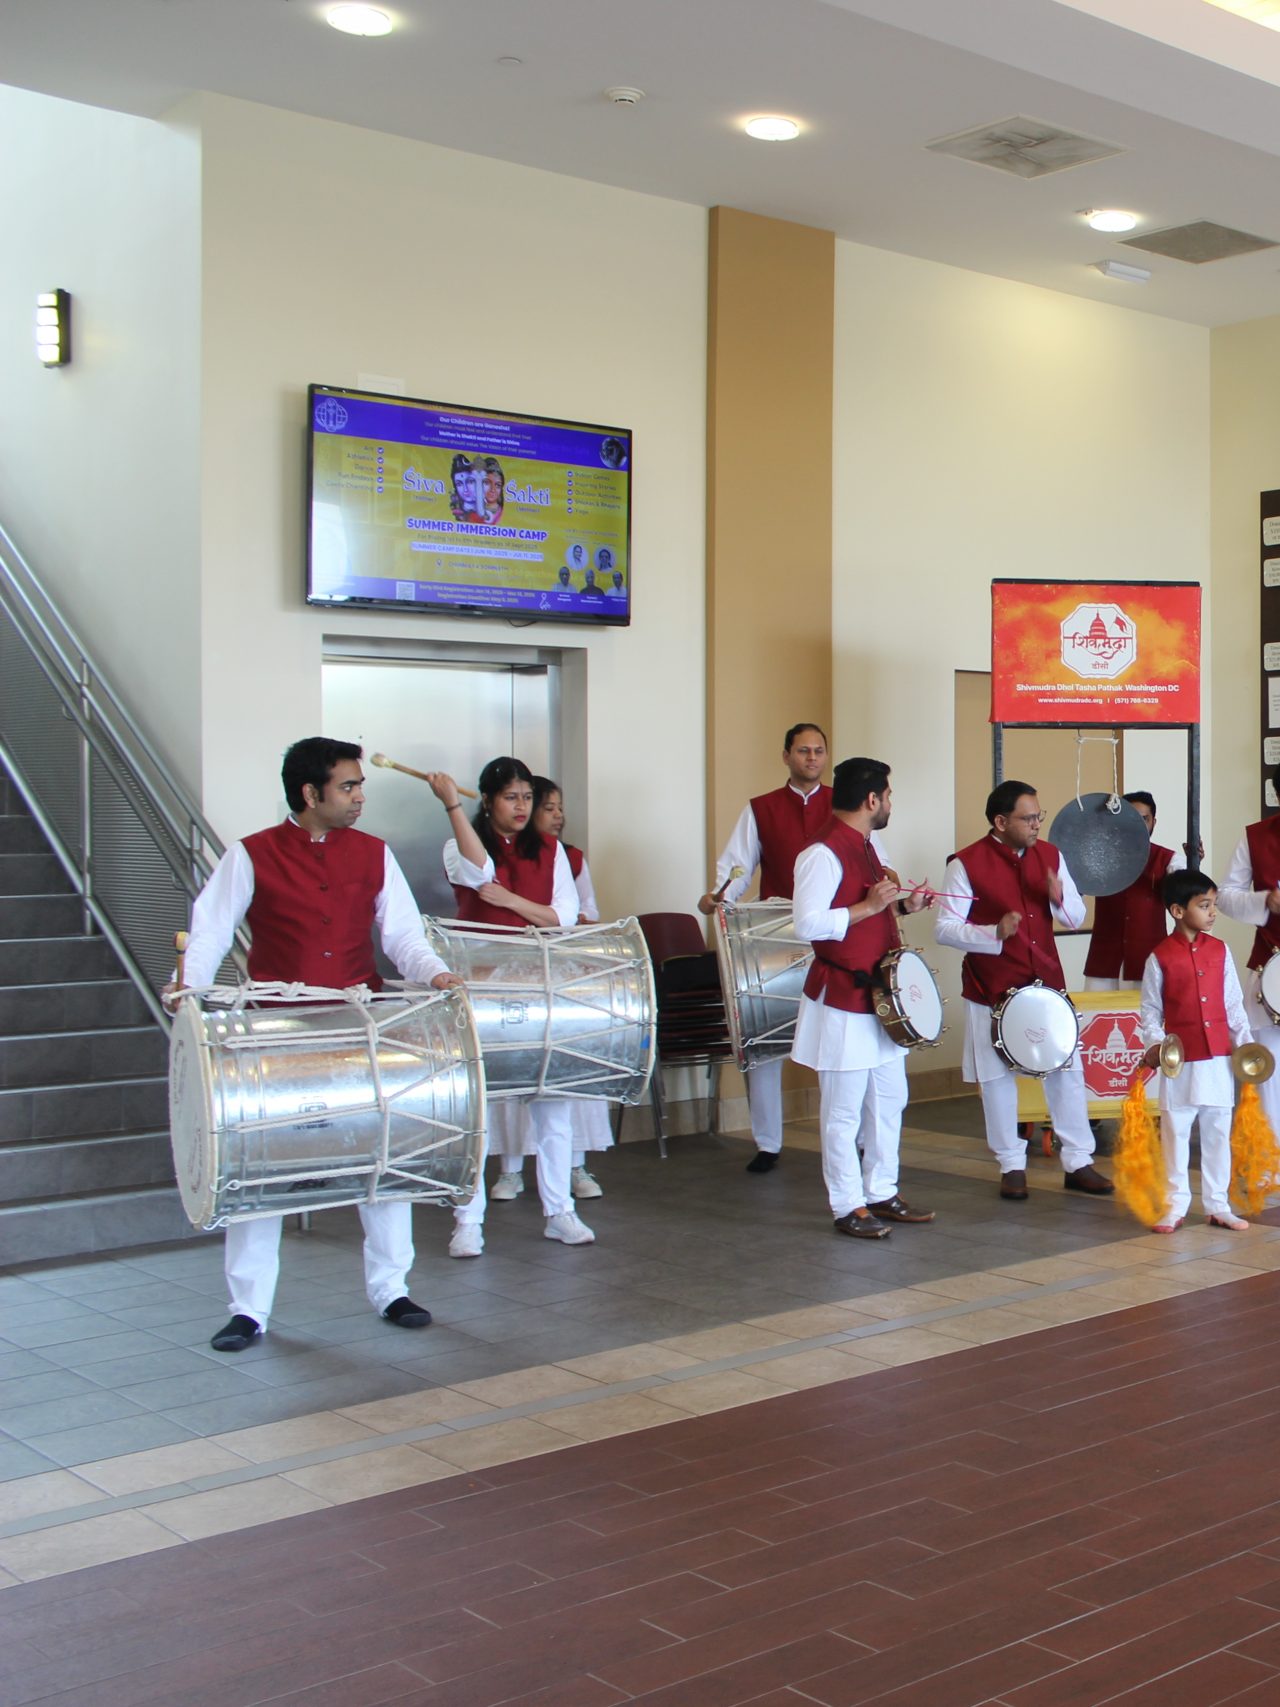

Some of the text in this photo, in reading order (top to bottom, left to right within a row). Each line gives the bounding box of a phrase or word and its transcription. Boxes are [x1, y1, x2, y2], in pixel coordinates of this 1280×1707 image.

[407, 518, 455, 533] SUMMER
[456, 523, 517, 538] IMMERSION
[518, 529, 548, 541] CAMP
[1016, 684, 1180, 693] Shivmudra Dhol Tasha Pathak Washington DC
[1107, 1076, 1128, 1088] डीसी
